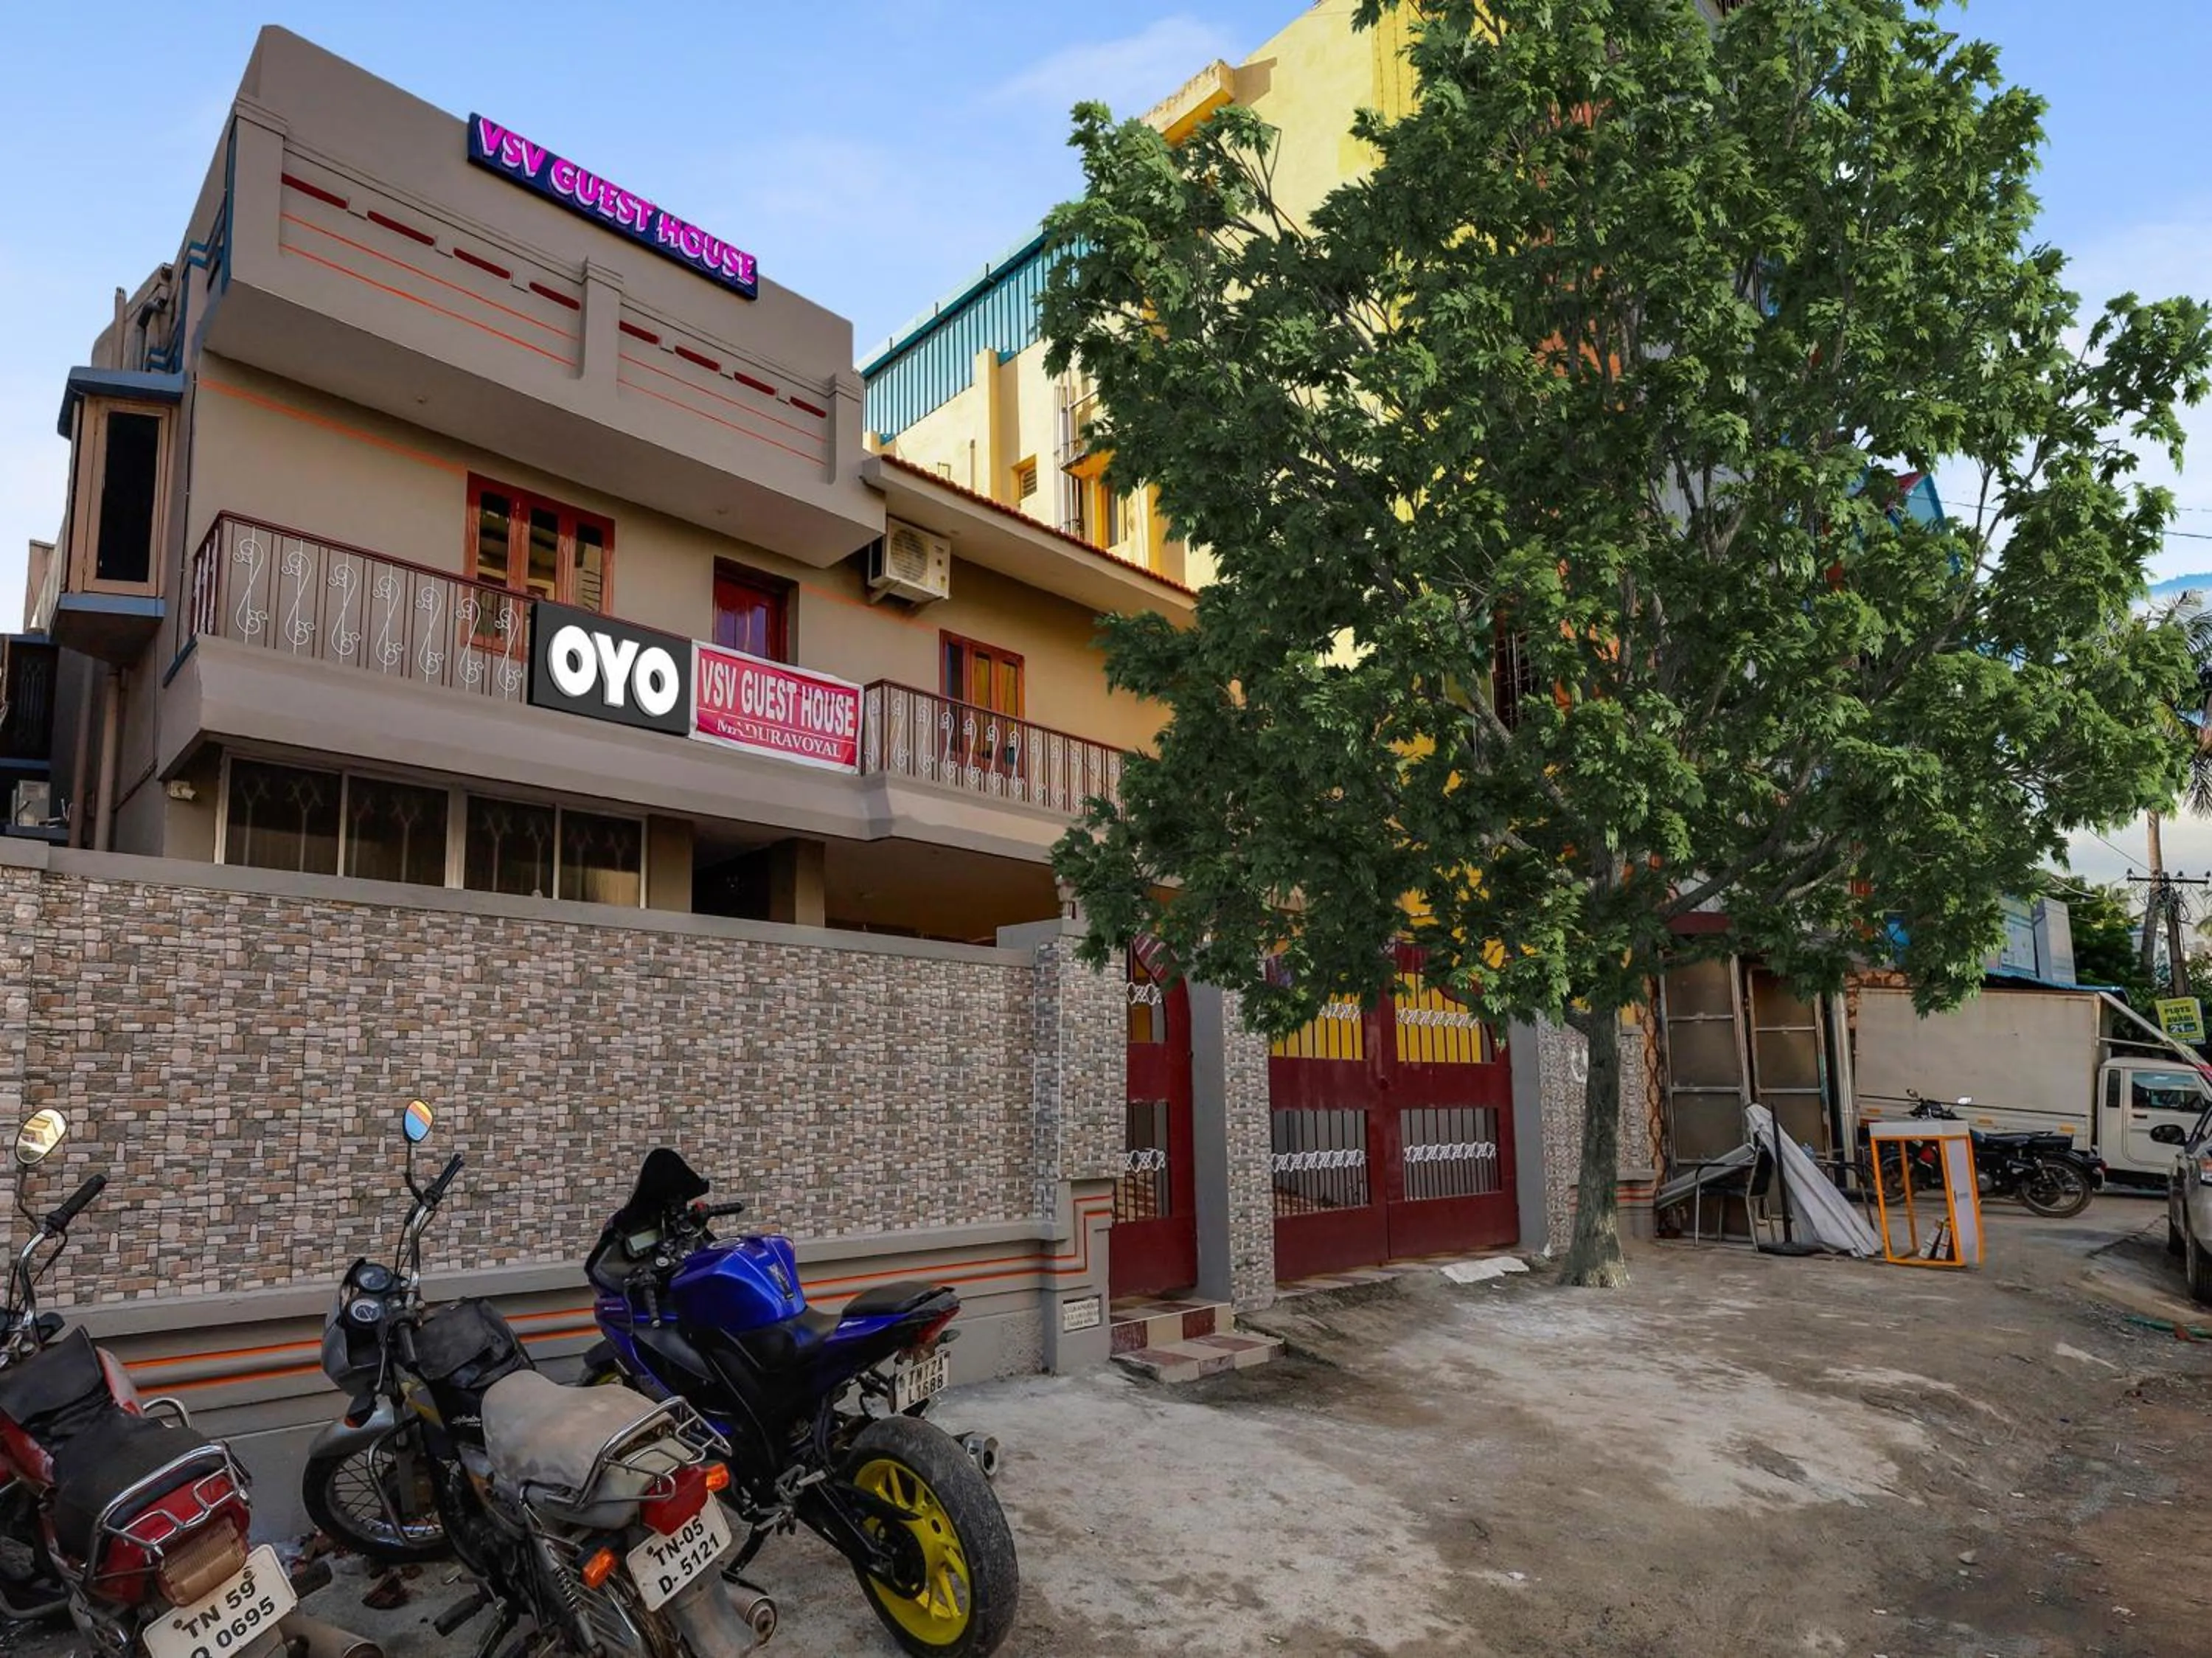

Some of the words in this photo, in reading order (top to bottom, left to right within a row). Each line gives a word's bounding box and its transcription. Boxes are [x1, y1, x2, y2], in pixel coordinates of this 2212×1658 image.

[479, 117, 547, 178] VSV
[551, 159, 657, 233] GUEST
[658, 212, 758, 285] HOUSE
[547, 625, 680, 717] OYO
[701, 658, 737, 710] VSV
[741, 669, 797, 724] GUEST
[801, 685, 855, 738] HOUSE
[680, 1532, 720, 1576] 5121
[181, 1604, 221, 1640] TN
[225, 1579, 257, 1609] 59
[216, 1595, 276, 1648] 0695
